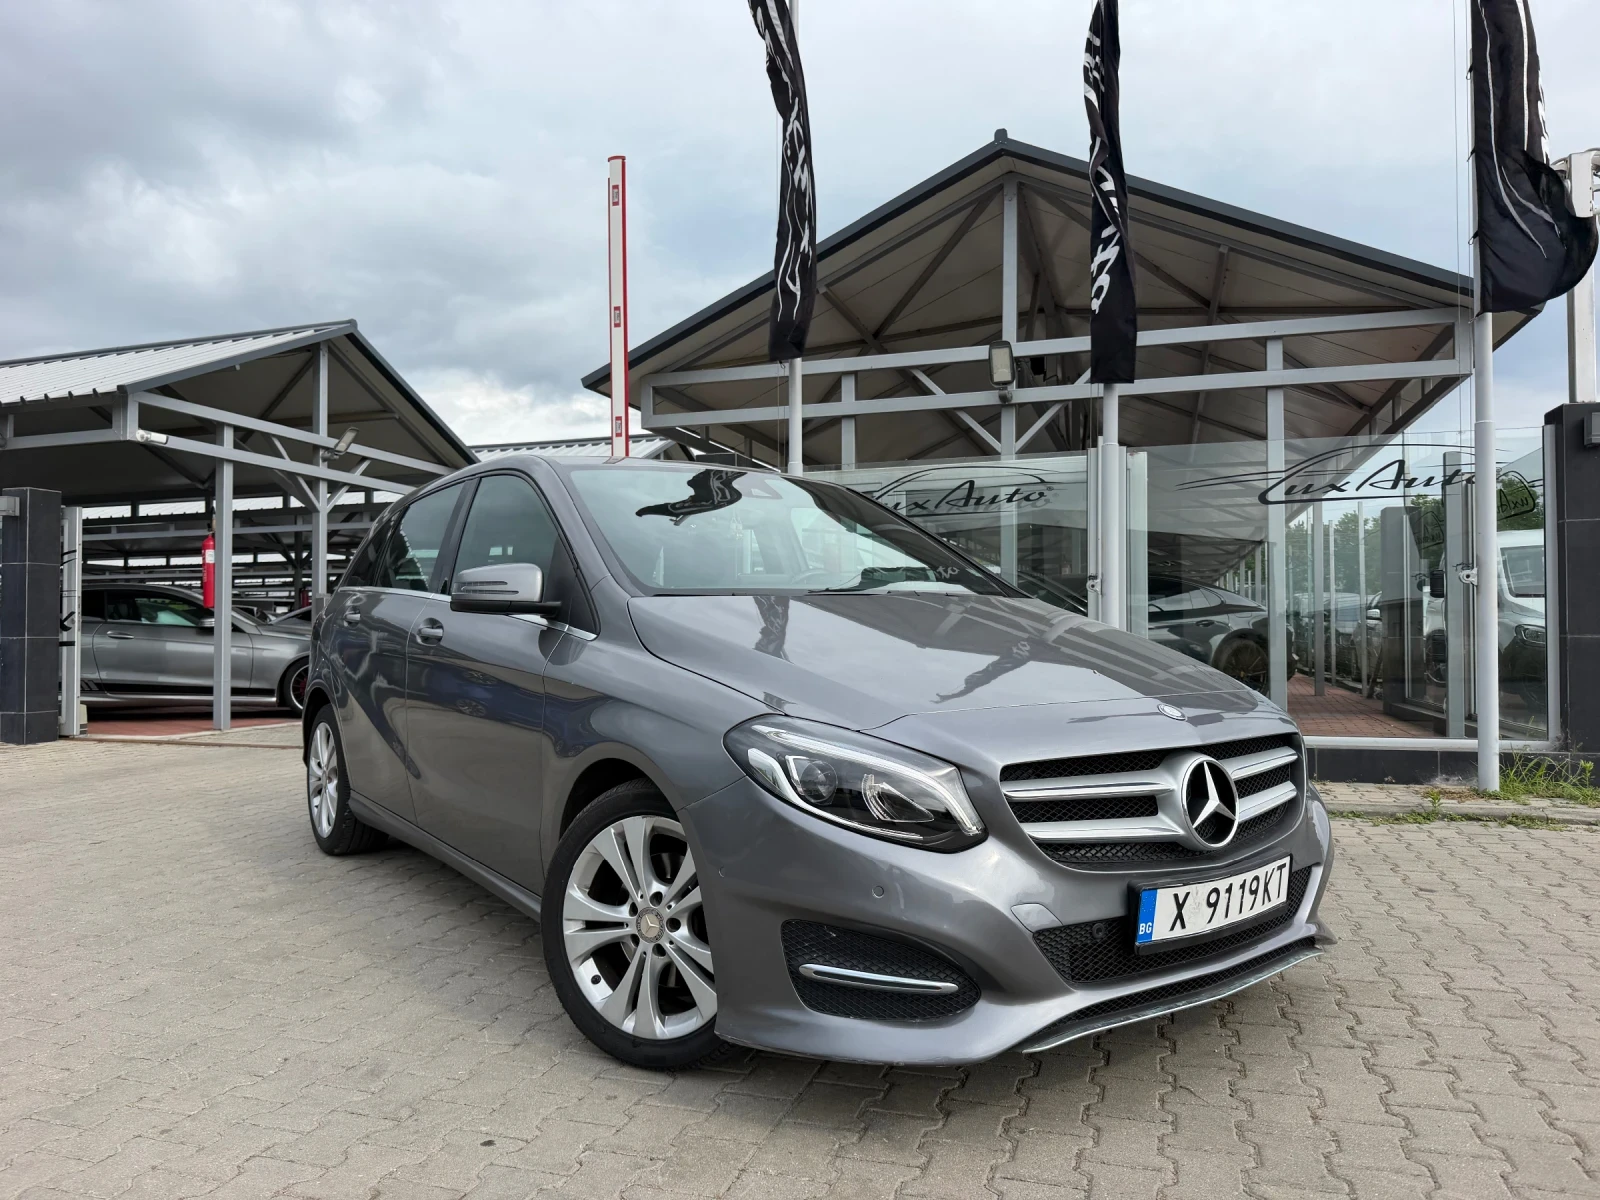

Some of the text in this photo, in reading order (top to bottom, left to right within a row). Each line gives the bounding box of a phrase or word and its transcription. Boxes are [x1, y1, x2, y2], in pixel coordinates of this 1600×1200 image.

[1169, 862, 1287, 932] X 9119KT
[1139, 922, 1153, 935] BG
